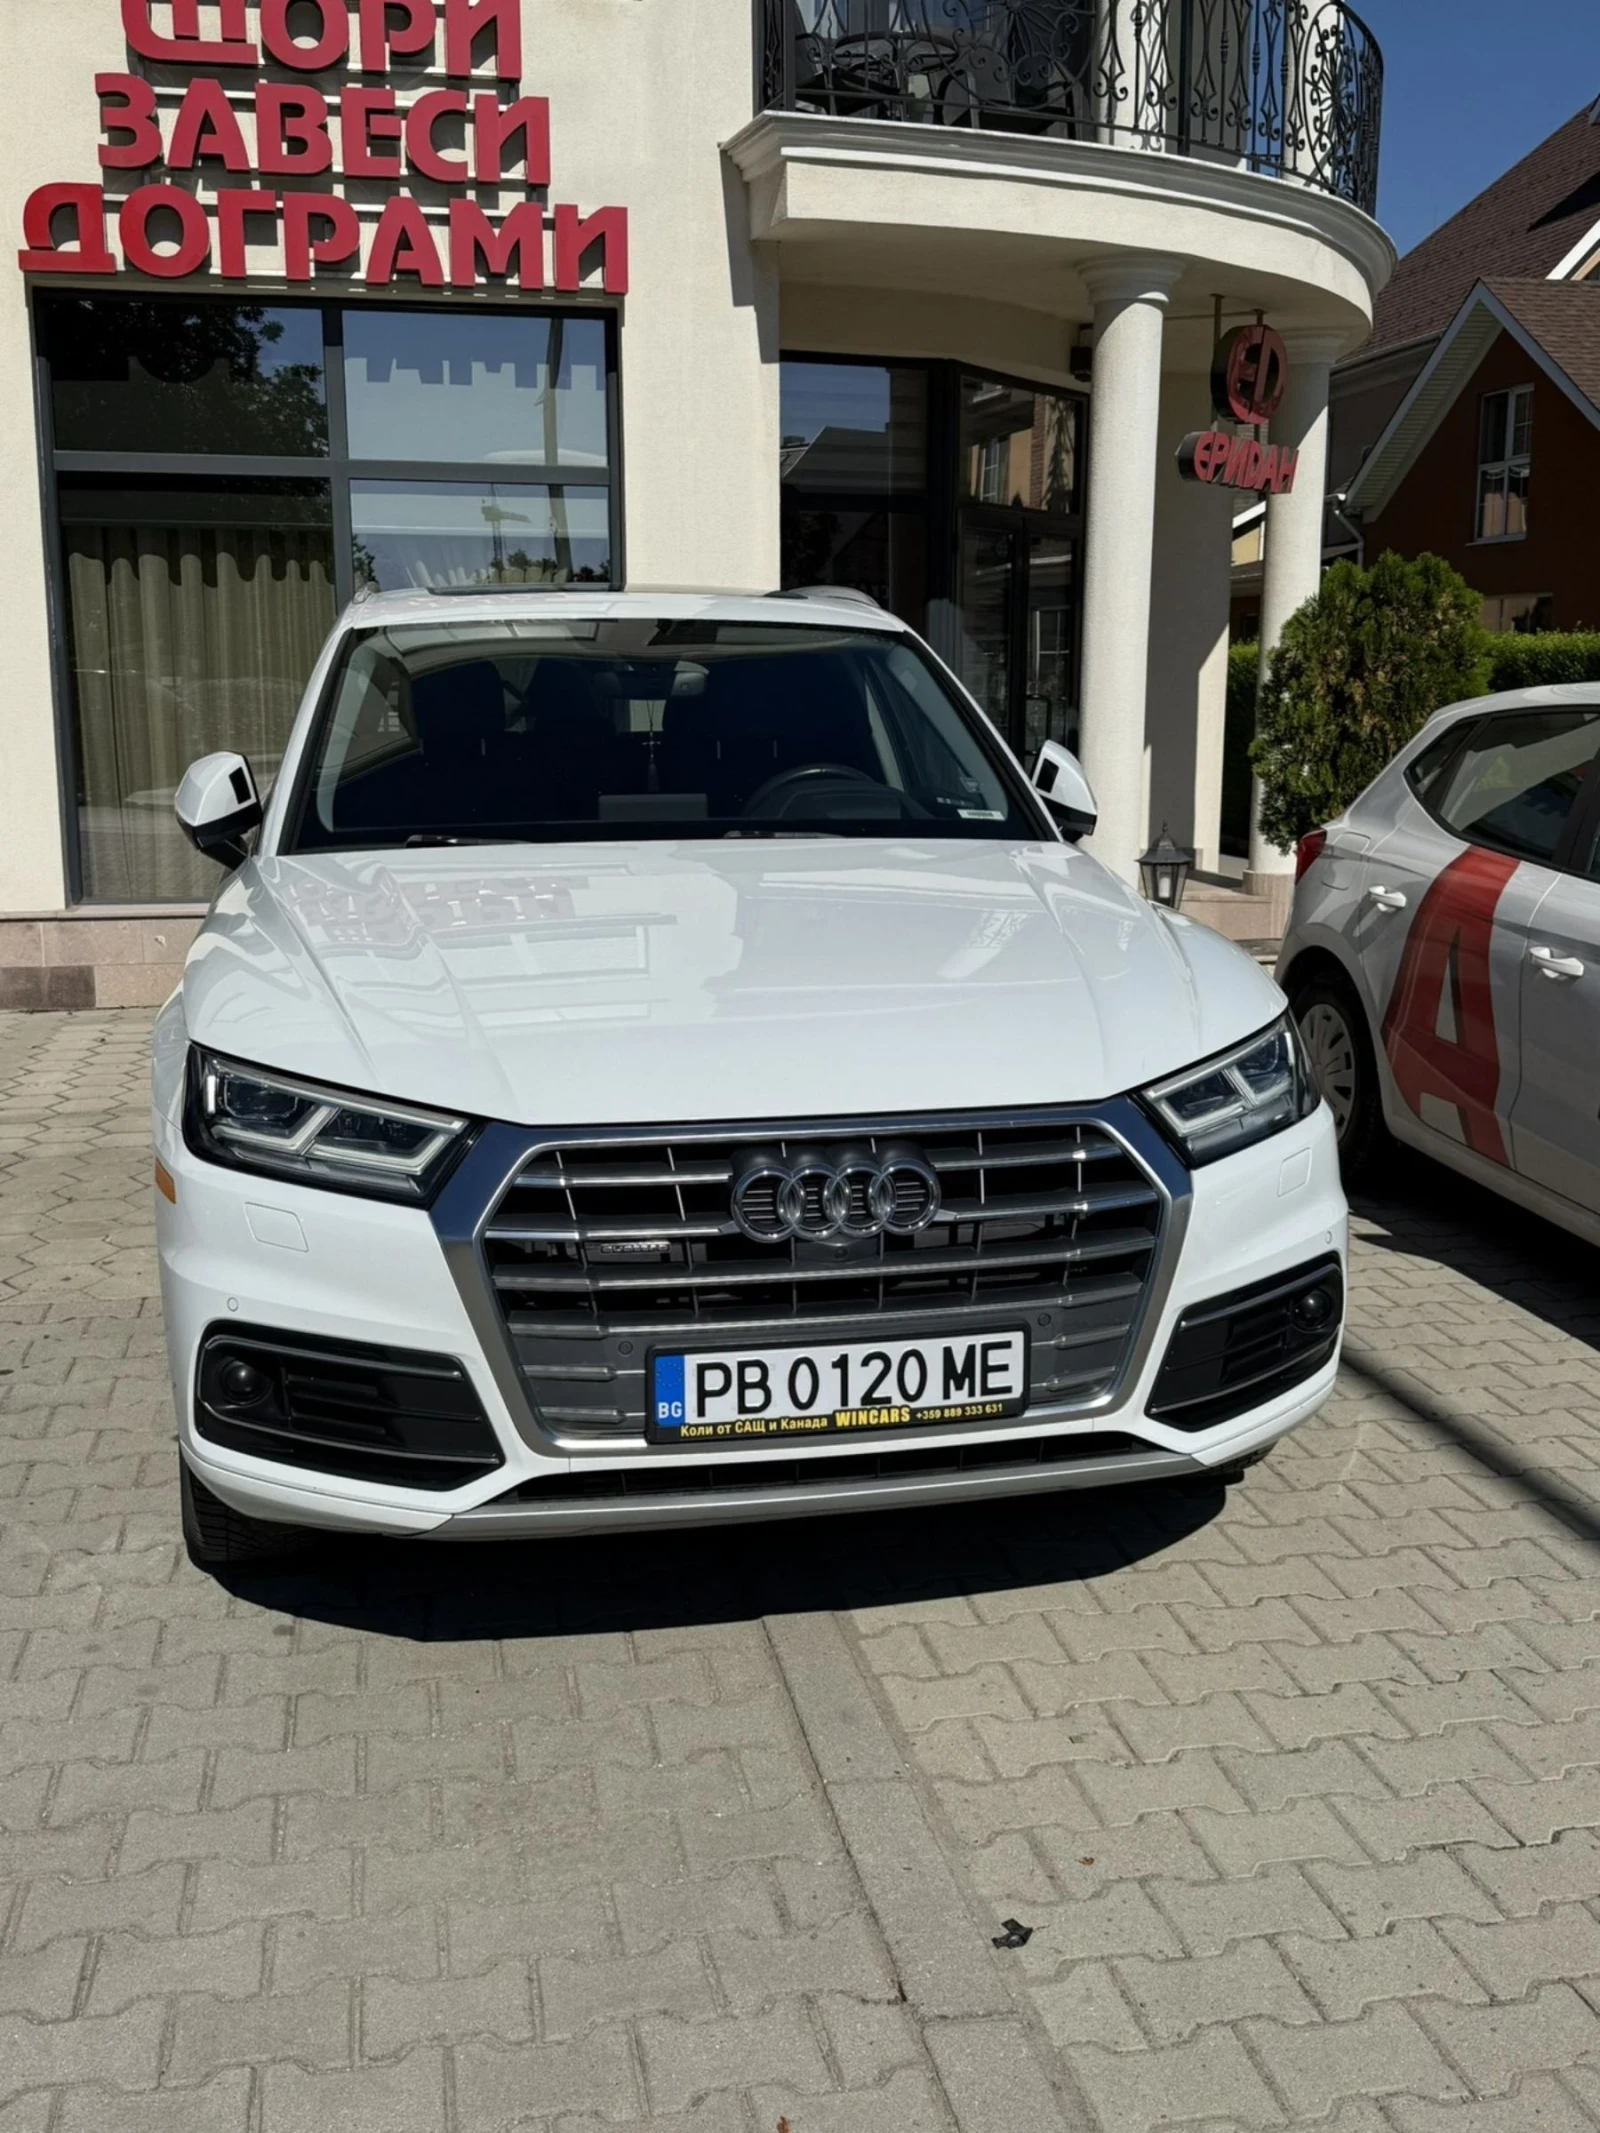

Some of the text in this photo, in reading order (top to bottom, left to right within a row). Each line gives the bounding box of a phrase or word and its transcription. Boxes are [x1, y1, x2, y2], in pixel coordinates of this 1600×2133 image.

[121, 0, 521, 82] ЩОРИ
[95, 73, 550, 187] ЗАВЕСИ
[18, 182, 628, 295] ДОГРАМИ
[658, 1401, 683, 1418] BG
[696, 1340, 1013, 1418] PB 0120 ME
[680, 1424, 714, 1437] Коли
[717, 1424, 732, 1435] от
[735, 1419, 766, 1433] САЩ
[769, 1420, 778, 1431] и
[781, 1416, 829, 1431] Канада
[835, 1407, 911, 1427] WINCARS
[916, 1409, 942, 1420] +359
[943, 1406, 962, 1417] 889
[964, 1404, 984, 1416] 333
